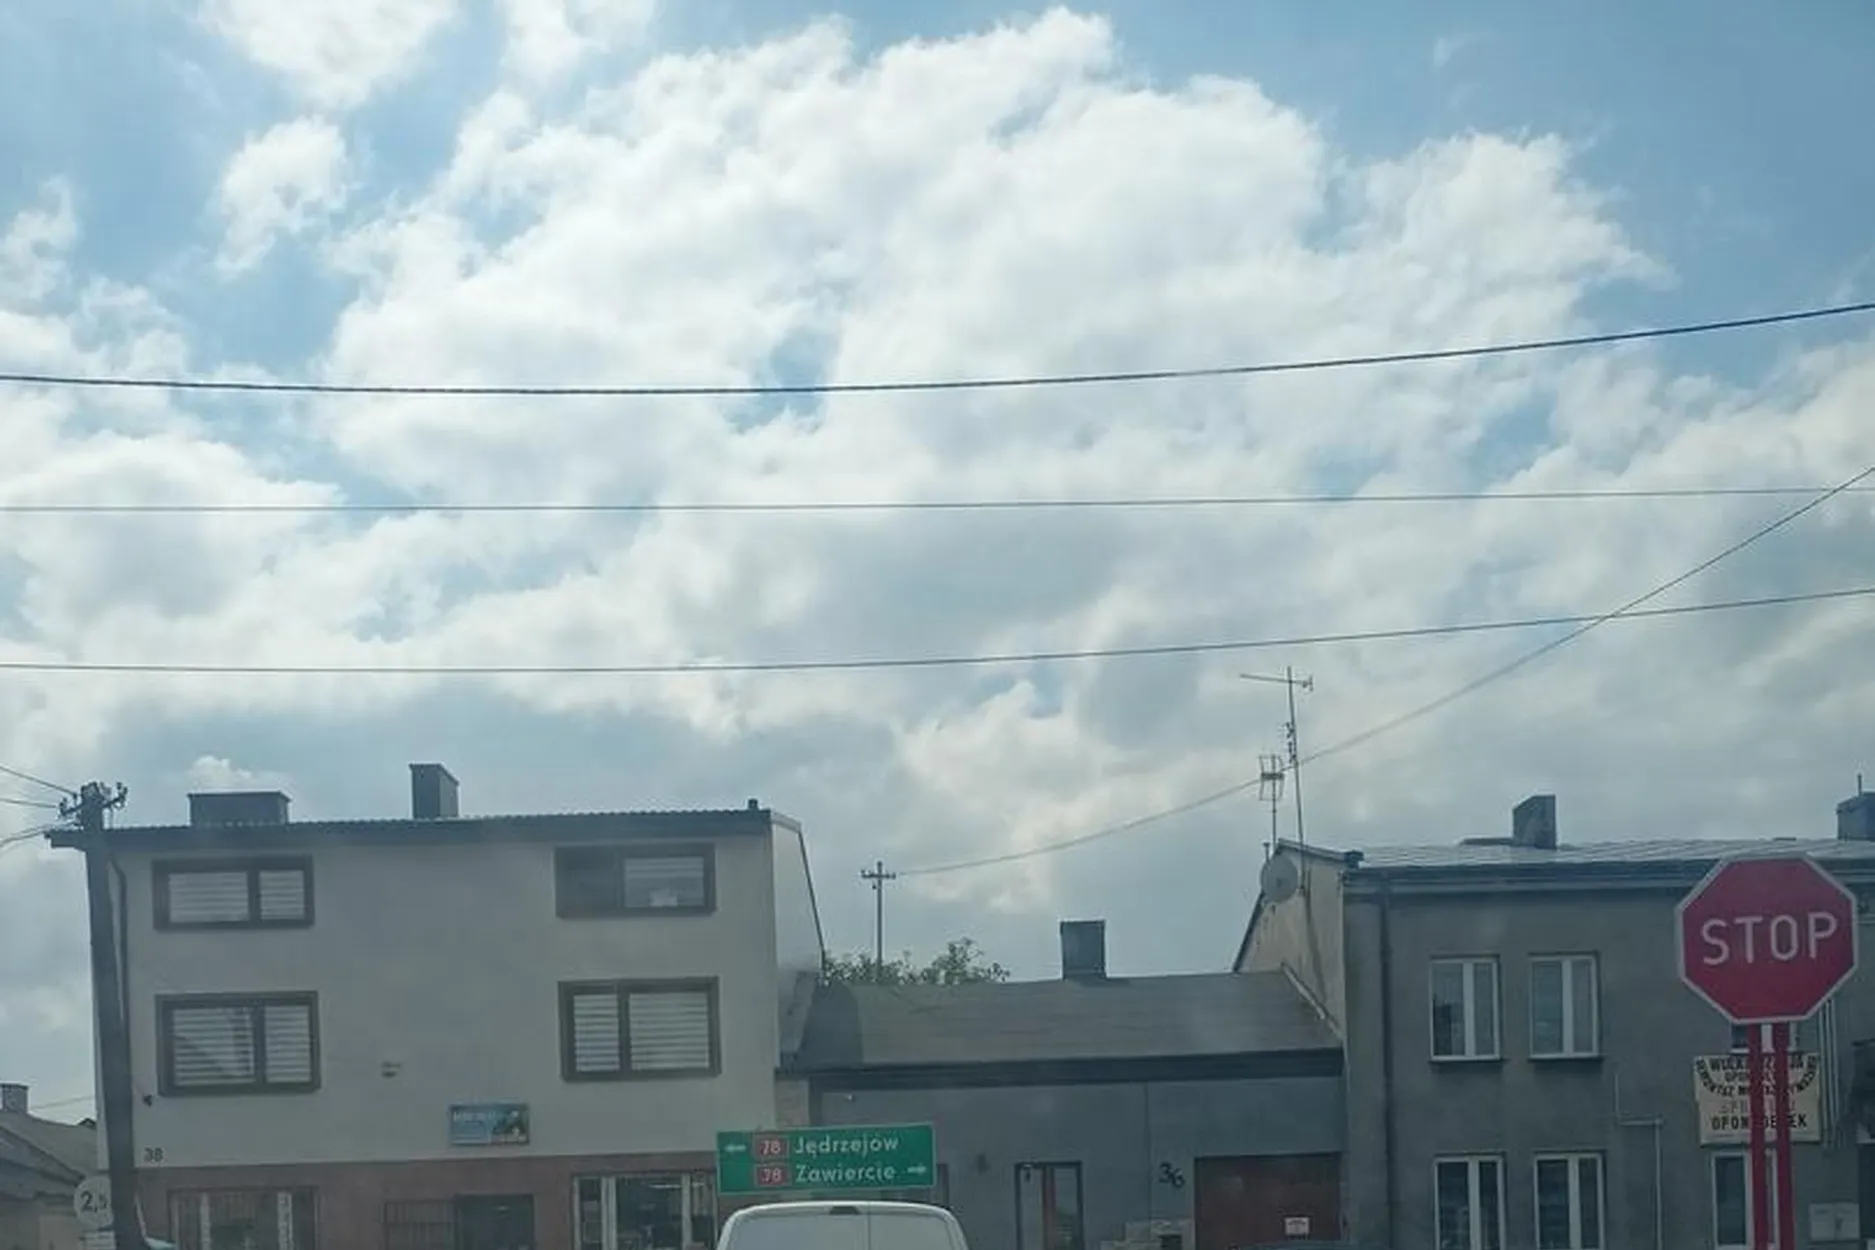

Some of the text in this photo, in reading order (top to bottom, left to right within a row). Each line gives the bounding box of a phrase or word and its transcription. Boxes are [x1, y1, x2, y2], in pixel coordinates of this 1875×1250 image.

[1701, 911, 1837, 966] STOP
[144, 1147, 163, 1162] 38
[795, 1133, 899, 1158] Jędrzejów
[795, 1161, 896, 1182] Zawiercie
[1159, 1162, 1185, 1188] 36
